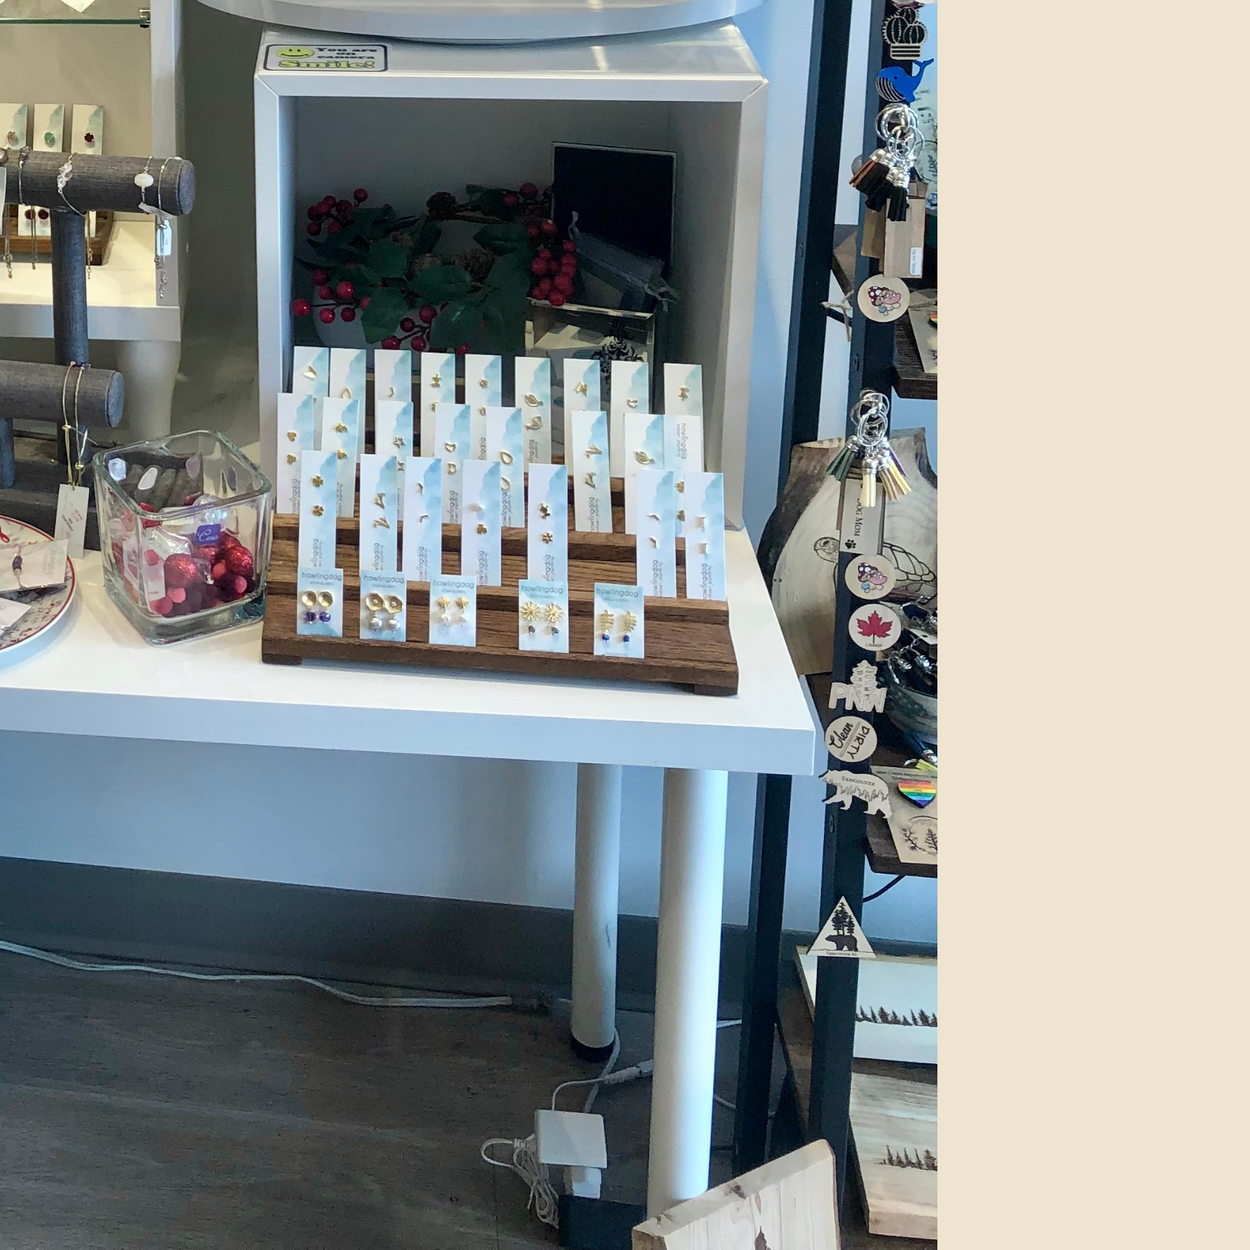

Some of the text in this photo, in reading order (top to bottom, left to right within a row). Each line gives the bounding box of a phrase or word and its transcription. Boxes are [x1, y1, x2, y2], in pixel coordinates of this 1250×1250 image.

[278, 60, 375, 69] Smile!
[301, 572, 342, 582] howlingdog
[363, 574, 404, 584] howlingdog
[433, 579, 475, 590] howlingdog
[521, 585, 563, 595] howlingdog
[596, 588, 639, 599] howlingdog
[828, 682, 887, 713] PNW
[829, 722, 854, 749] Clean
[847, 725, 870, 759] DIRTY
